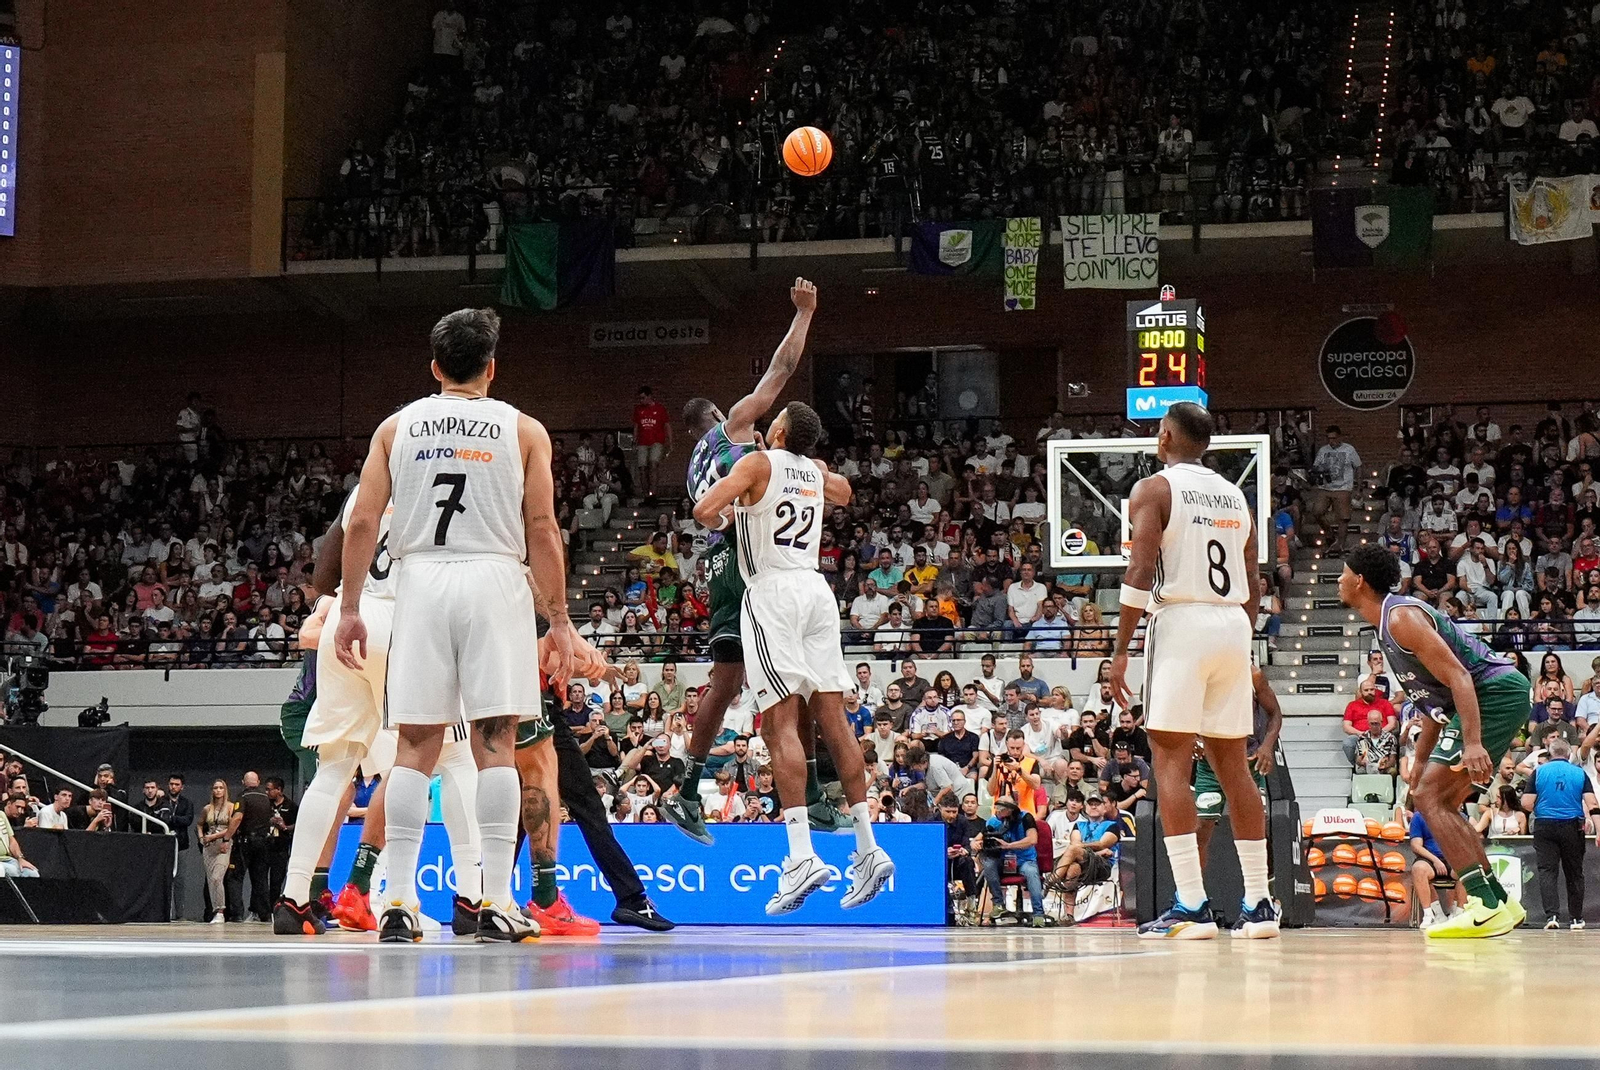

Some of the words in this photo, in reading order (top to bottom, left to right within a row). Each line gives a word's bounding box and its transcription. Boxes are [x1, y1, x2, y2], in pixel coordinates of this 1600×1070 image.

[929, 146, 944, 159] 25
[1008, 218, 1040, 232] ONE
[1067, 213, 1156, 236] SIEMPRE
[1005, 232, 1040, 248] MORE
[1064, 238, 1097, 260] TE
[1102, 235, 1160, 255] LLEVO
[1006, 248, 1039, 264] BABY
[1005, 265, 1037, 280] ONE
[1005, 280, 1036, 296] MORE
[1136, 314, 1187, 328] LOTUS
[594, 327, 648, 340] Grada
[656, 326, 704, 340] Oeste
[1144, 330, 1186, 348] 10:00
[1327, 350, 1407, 364] supercopa
[1139, 352, 1187, 386] 24
[1334, 362, 1407, 378] endesa
[409, 416, 500, 440] CAMPAZZO
[415, 448, 493, 462] AUTOHERO
[432, 472, 466, 546] 7
[774, 500, 814, 550] 22
[1207, 540, 1231, 597] 8
[1555, 782, 1566, 792] TV
[1324, 816, 1356, 824] Wilson
